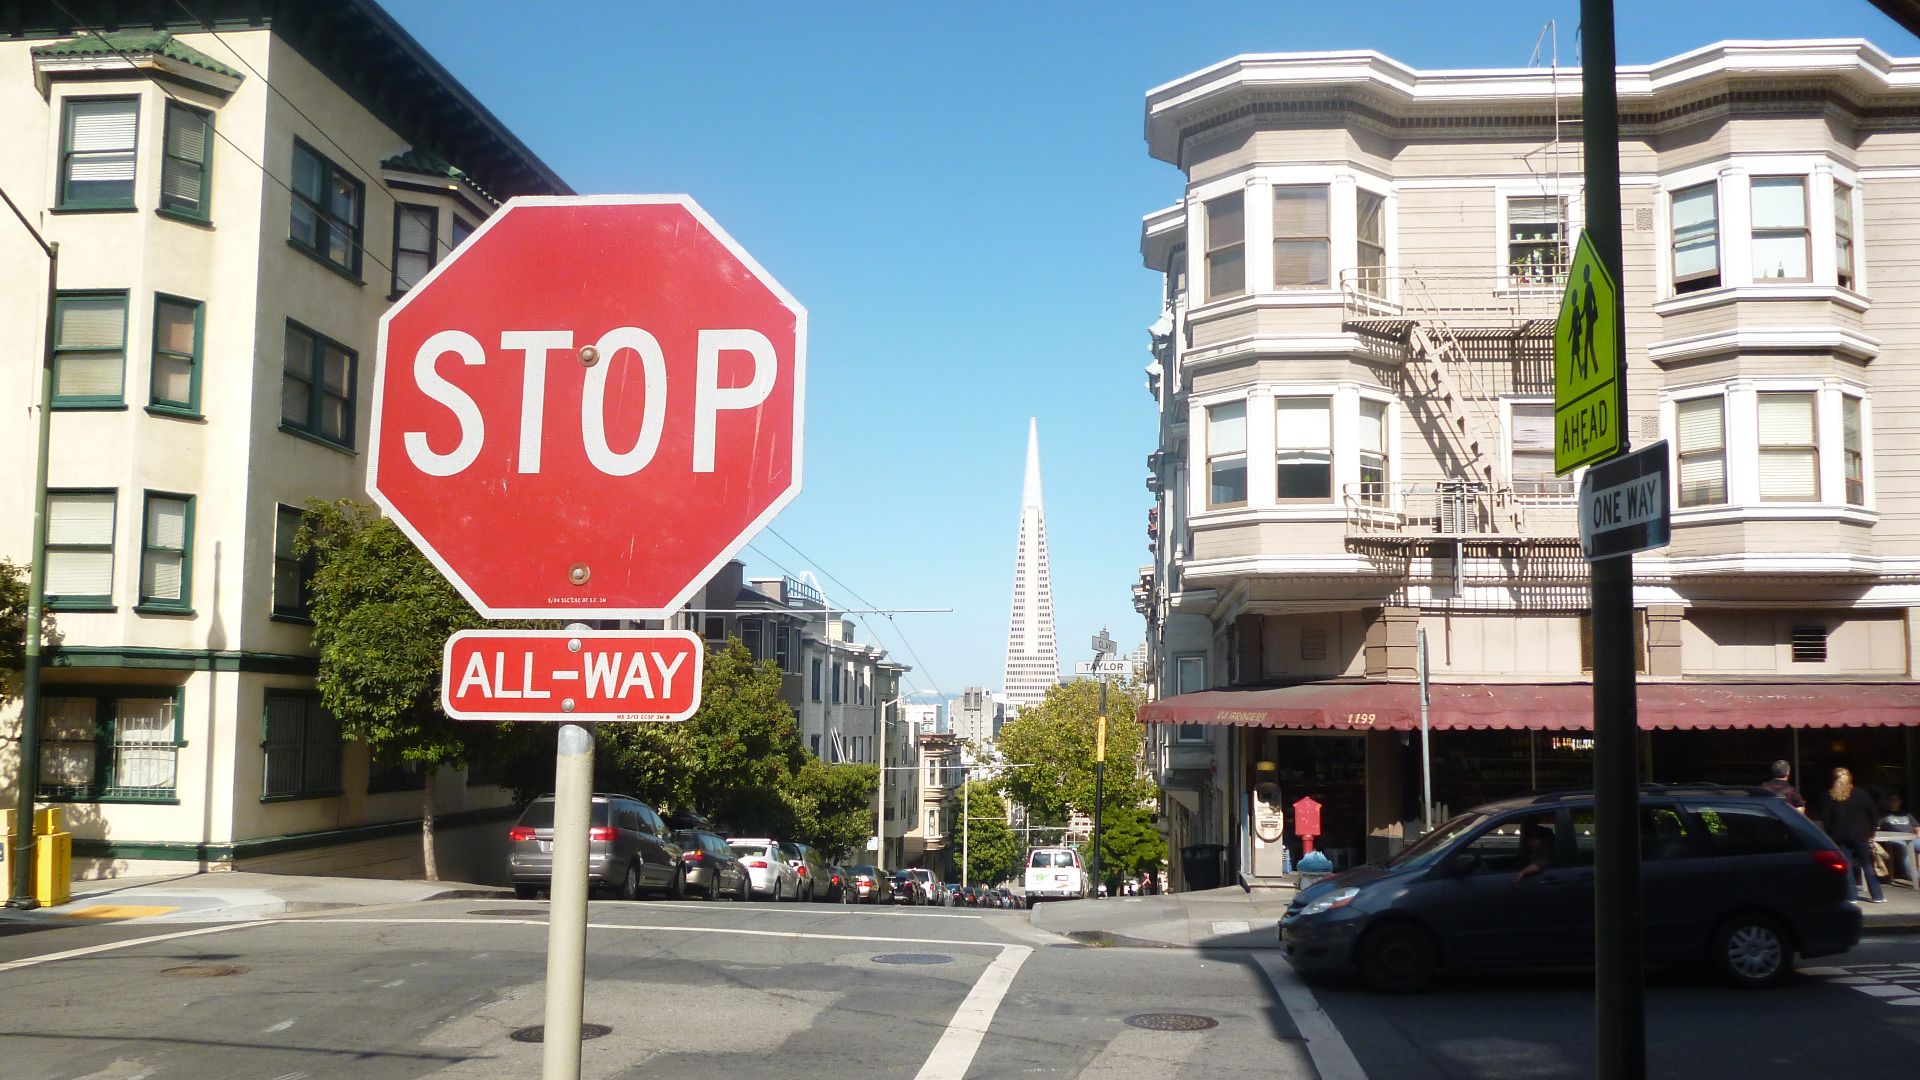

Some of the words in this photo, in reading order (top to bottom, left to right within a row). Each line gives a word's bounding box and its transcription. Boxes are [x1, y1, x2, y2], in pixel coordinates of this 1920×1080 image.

[403, 326, 778, 477] STOP
[1563, 400, 1608, 454] AHEAD
[1593, 491, 1622, 528] ONE
[1626, 479, 1656, 520] WAY
[456, 651, 688, 699] ALL-WAY
[1084, 662, 1124, 671] TAYLOR
[1347, 713, 1376, 724] 1199
